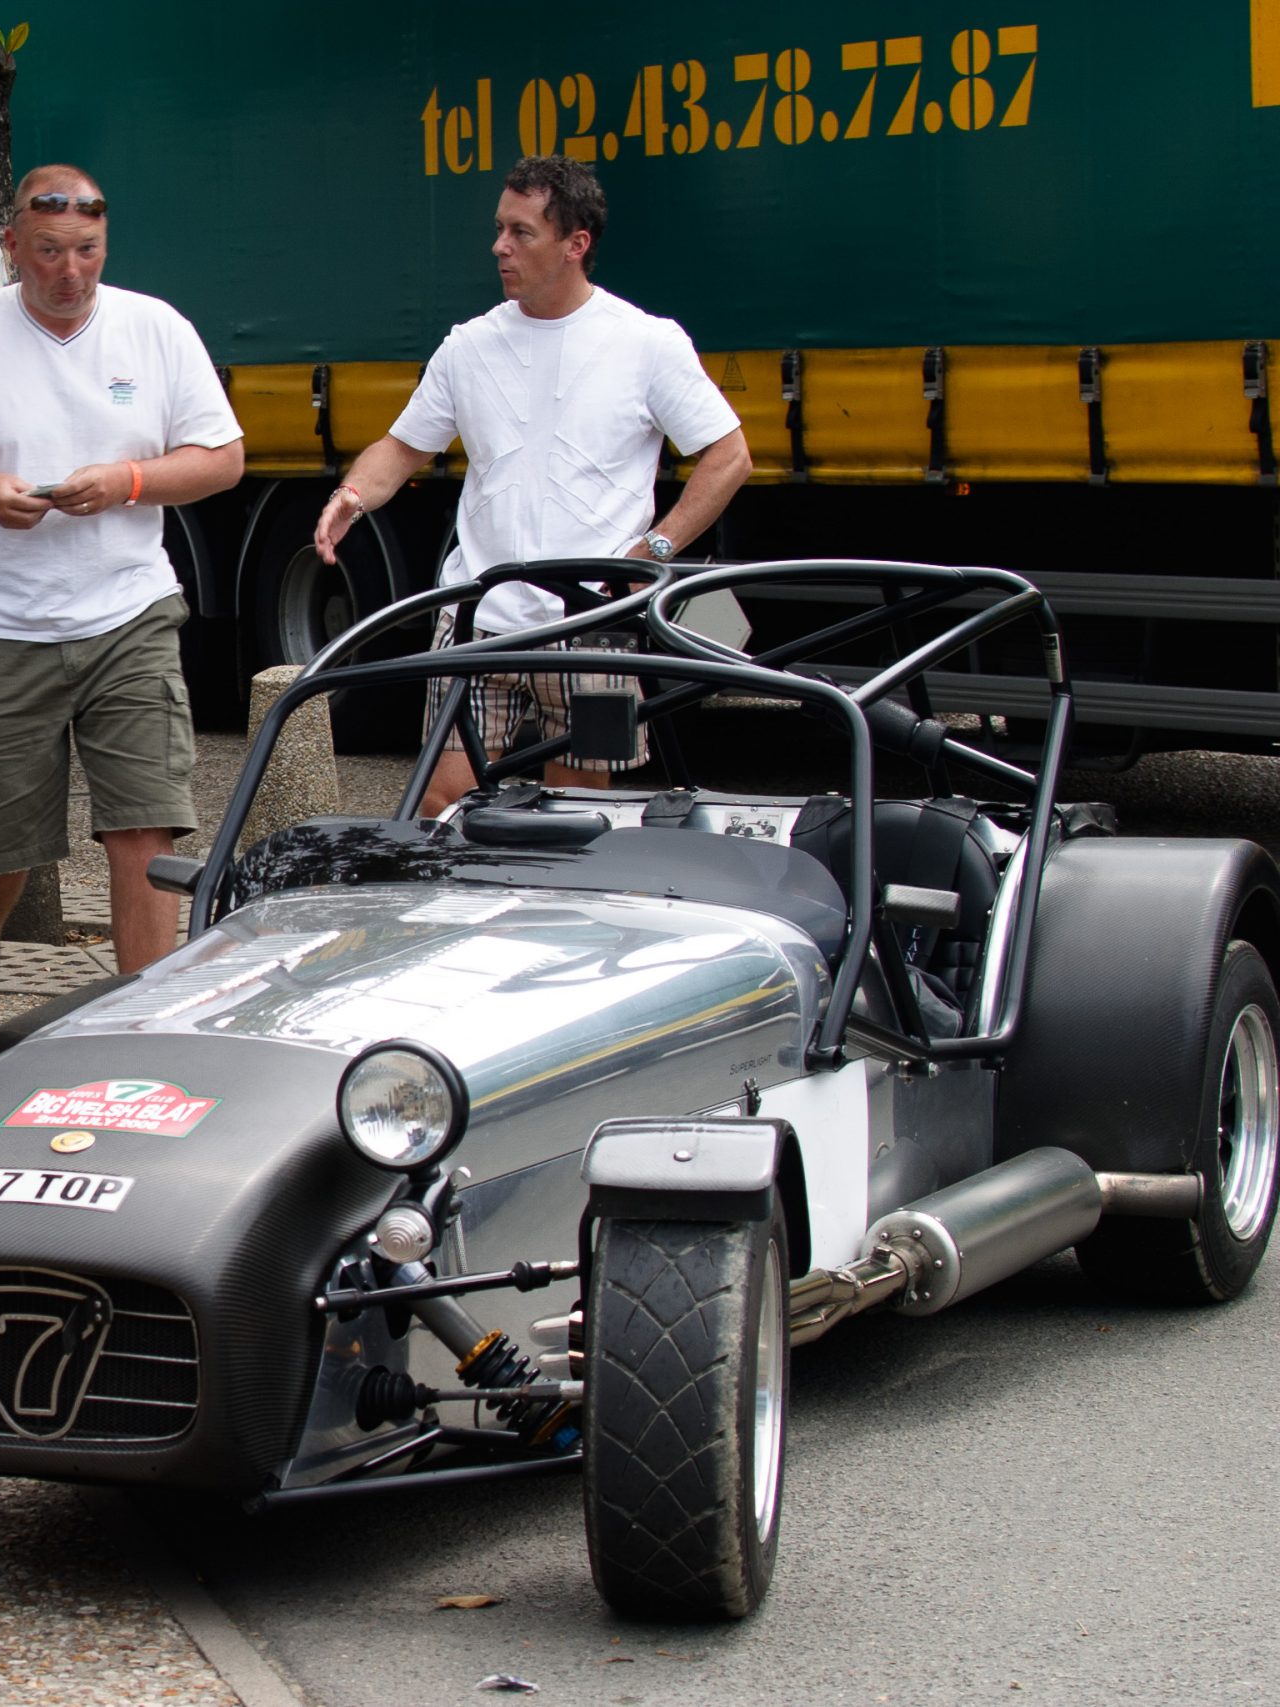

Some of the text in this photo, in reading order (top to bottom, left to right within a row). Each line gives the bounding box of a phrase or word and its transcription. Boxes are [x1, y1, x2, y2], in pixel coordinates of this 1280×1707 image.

[421, 24, 1038, 175] tel 02.43.78.77.87
[113, 1083, 156, 1100] 7
[21, 1092, 208, 1123] BIG WELSH BLAT
[32, 1115, 71, 1124] 2nd
[68, 1116, 120, 1127] JULY
[34, 1173, 124, 1204] TOP
